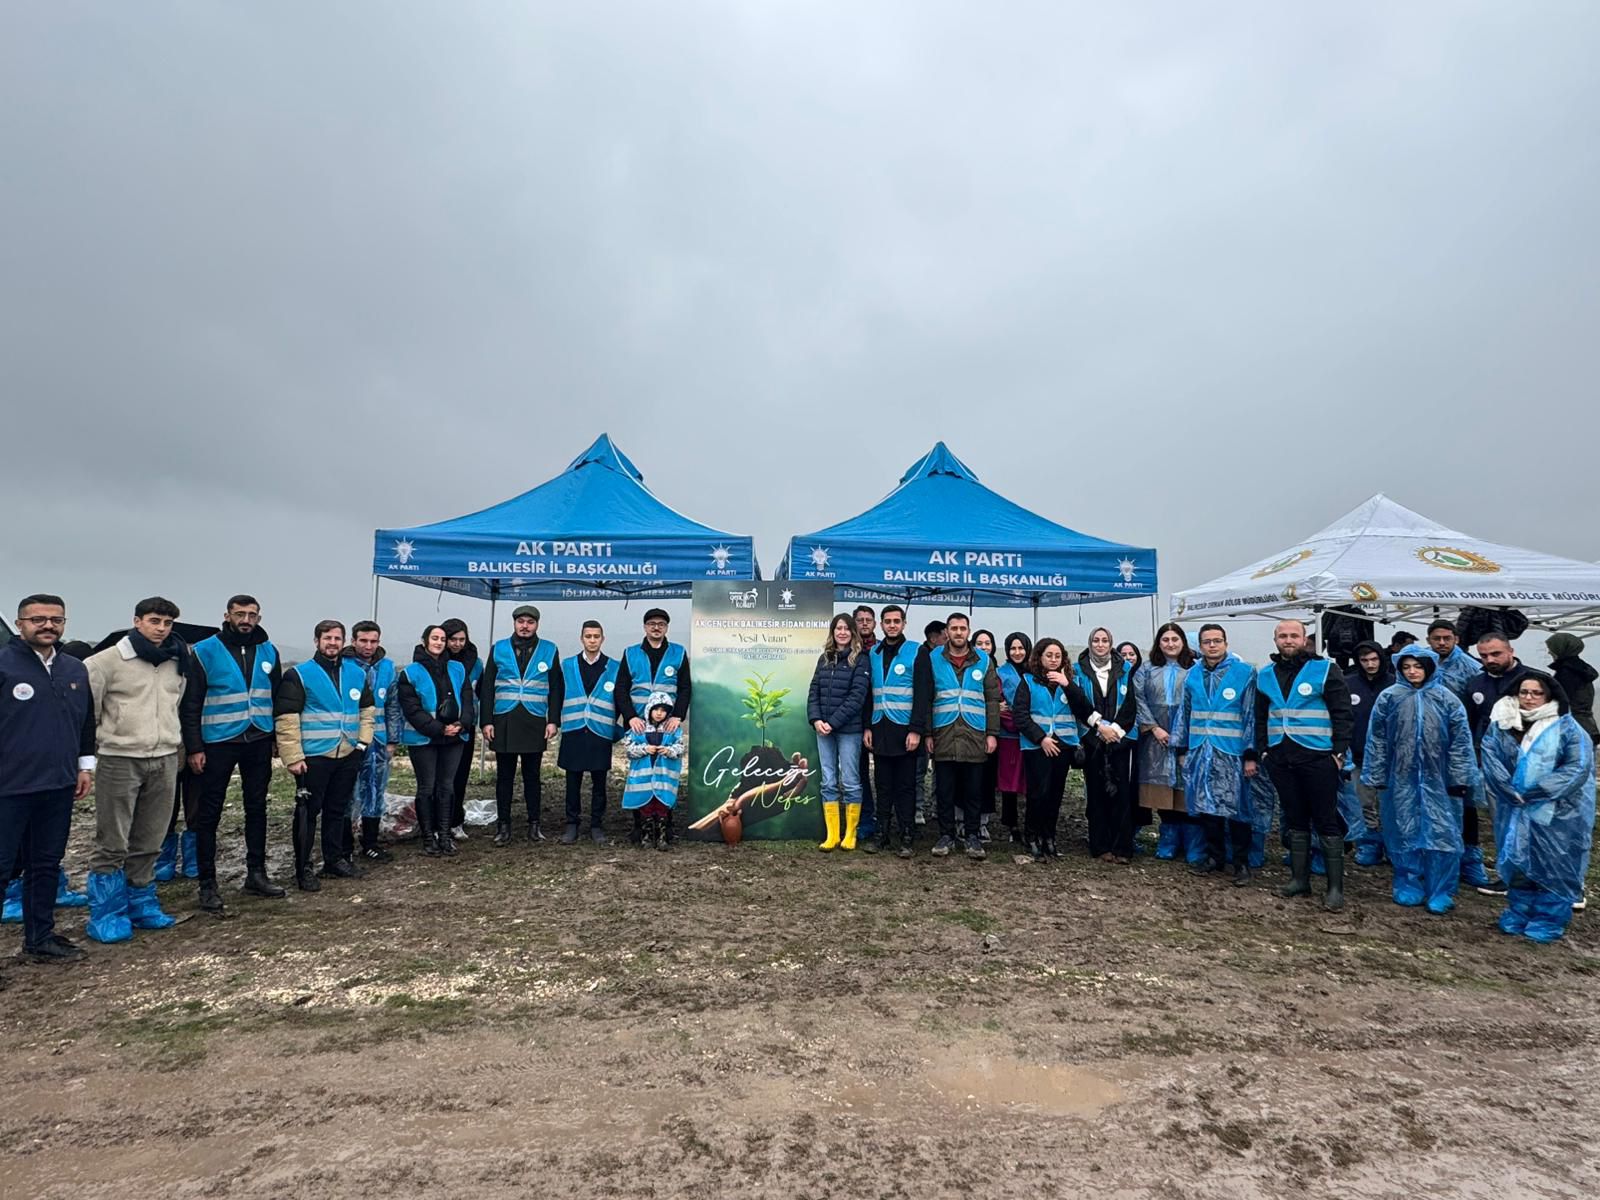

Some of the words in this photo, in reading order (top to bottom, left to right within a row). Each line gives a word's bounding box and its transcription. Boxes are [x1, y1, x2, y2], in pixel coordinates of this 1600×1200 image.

[516, 541, 546, 556] AK
[929, 551, 959, 565] AK
[468, 560, 546, 573] BALIKESİR
[550, 560, 563, 574] İL
[566, 562, 657, 576] BAŞKANLIĞI
[884, 569, 960, 583] BALIKESİR
[963, 570, 976, 584] İL
[979, 572, 1067, 587] BAŞKANLIĞI
[1389, 590, 1459, 599] BALIKESİR
[1460, 591, 1507, 600] ORMAN
[1508, 590, 1551, 600] BÖLGE
[695, 619, 706, 628] AK
[740, 618, 780, 628] BALIKESİR
[782, 618, 804, 629] FİDAN
[805, 619, 830, 629] DİKİMİ
[750, 781, 817, 811] Nefes
